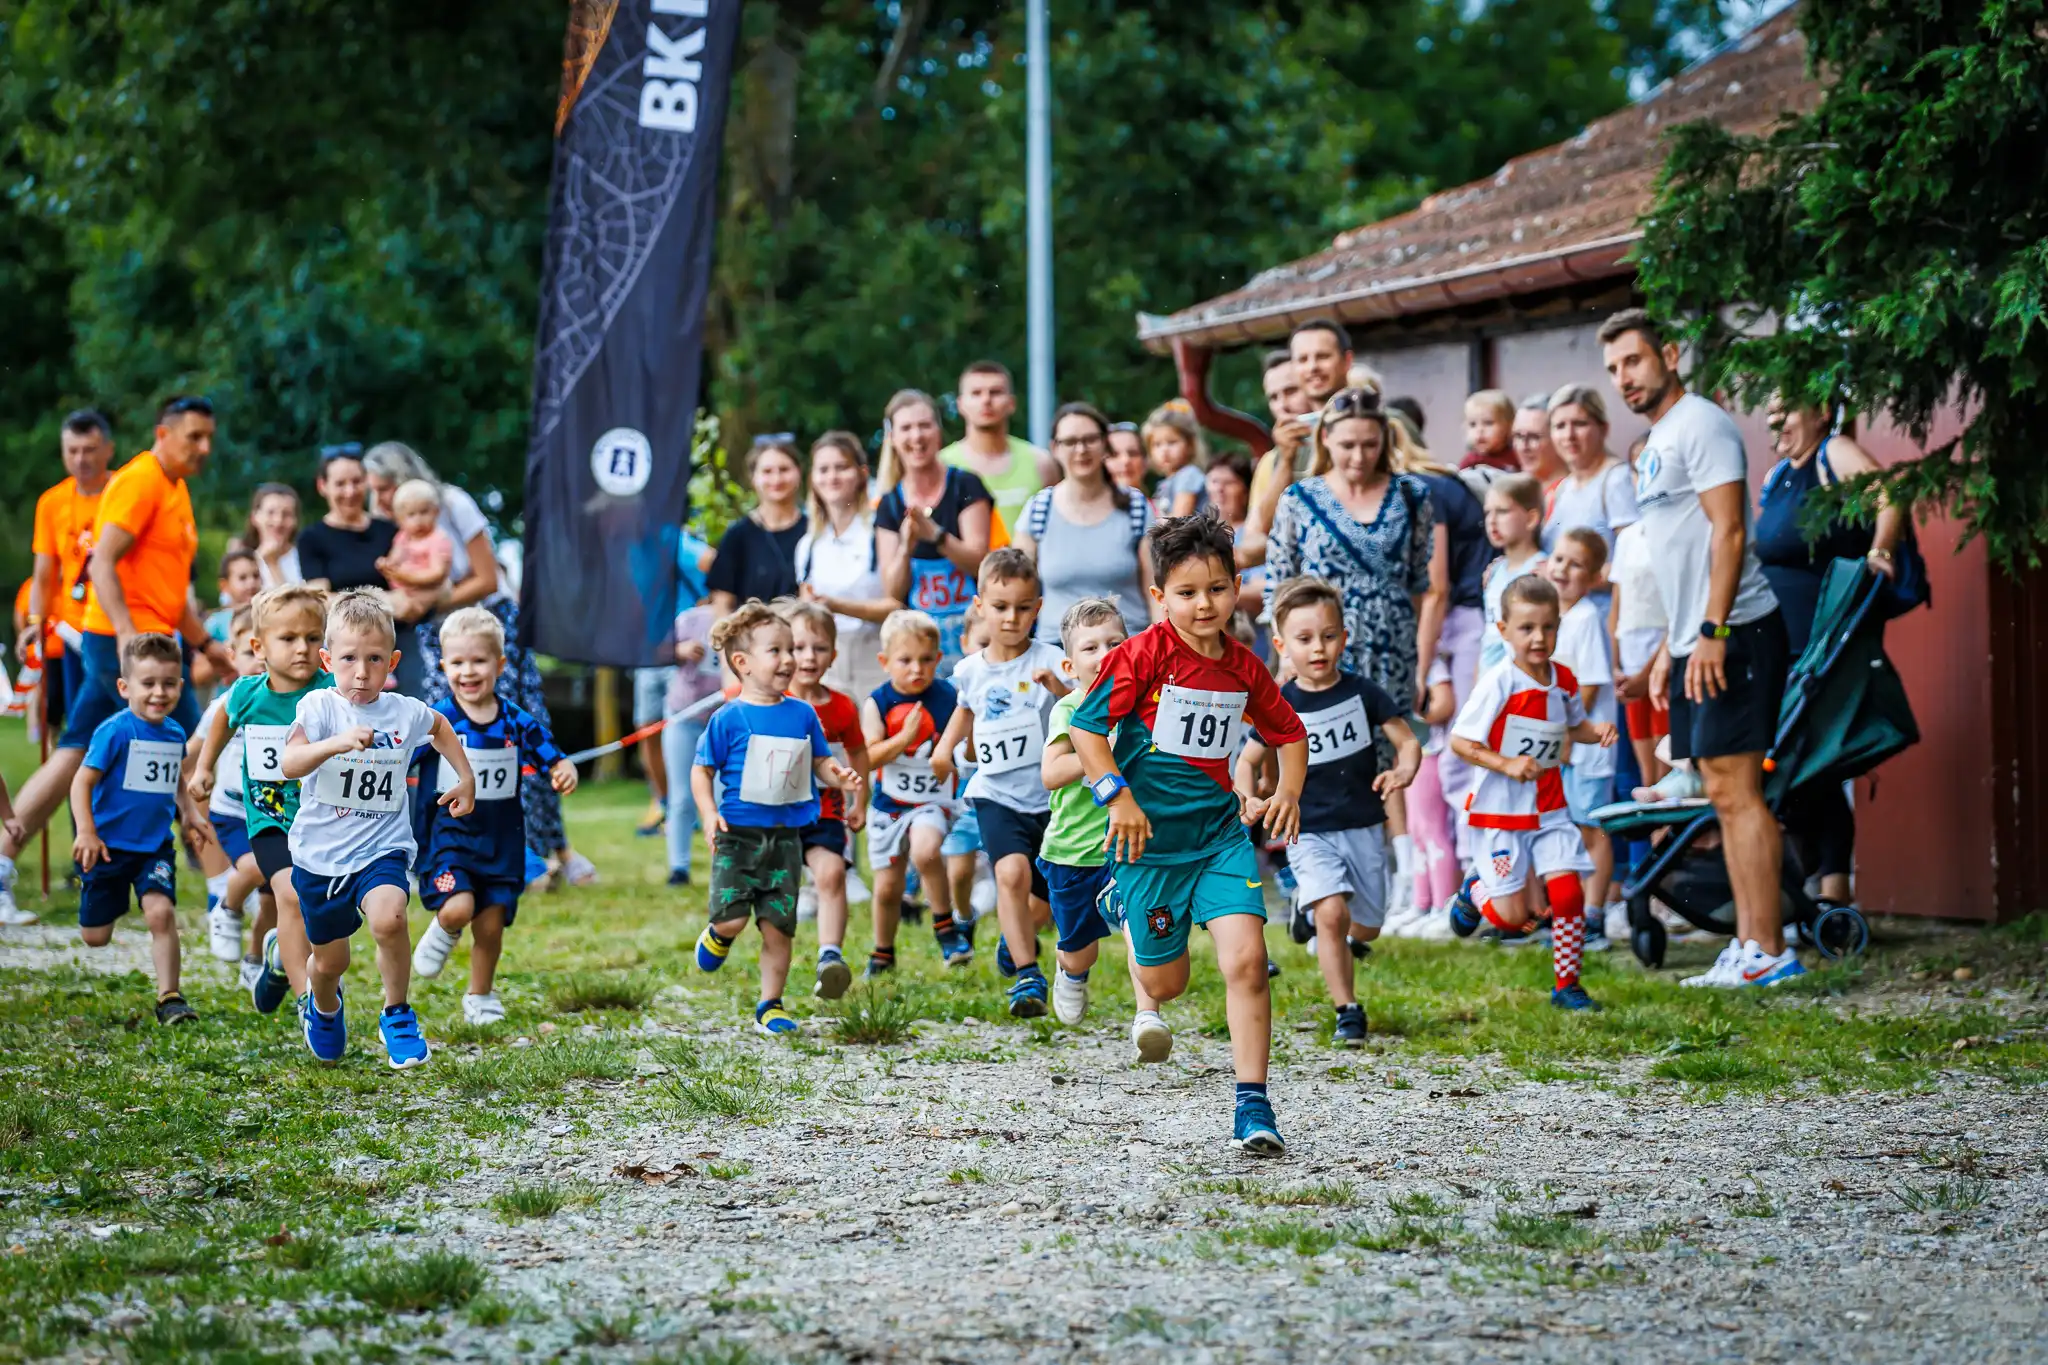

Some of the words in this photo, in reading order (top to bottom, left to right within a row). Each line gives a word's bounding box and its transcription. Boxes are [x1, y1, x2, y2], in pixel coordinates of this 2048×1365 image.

[1180, 712, 1231, 748] 191
[1307, 721, 1358, 754] 314
[263, 747, 278, 770] 3
[979, 735, 1028, 764] 317
[339, 768, 393, 802] 184
[478, 768, 507, 789] 19
[897, 772, 941, 793] 352
[355, 811, 385, 820] FAMILY
